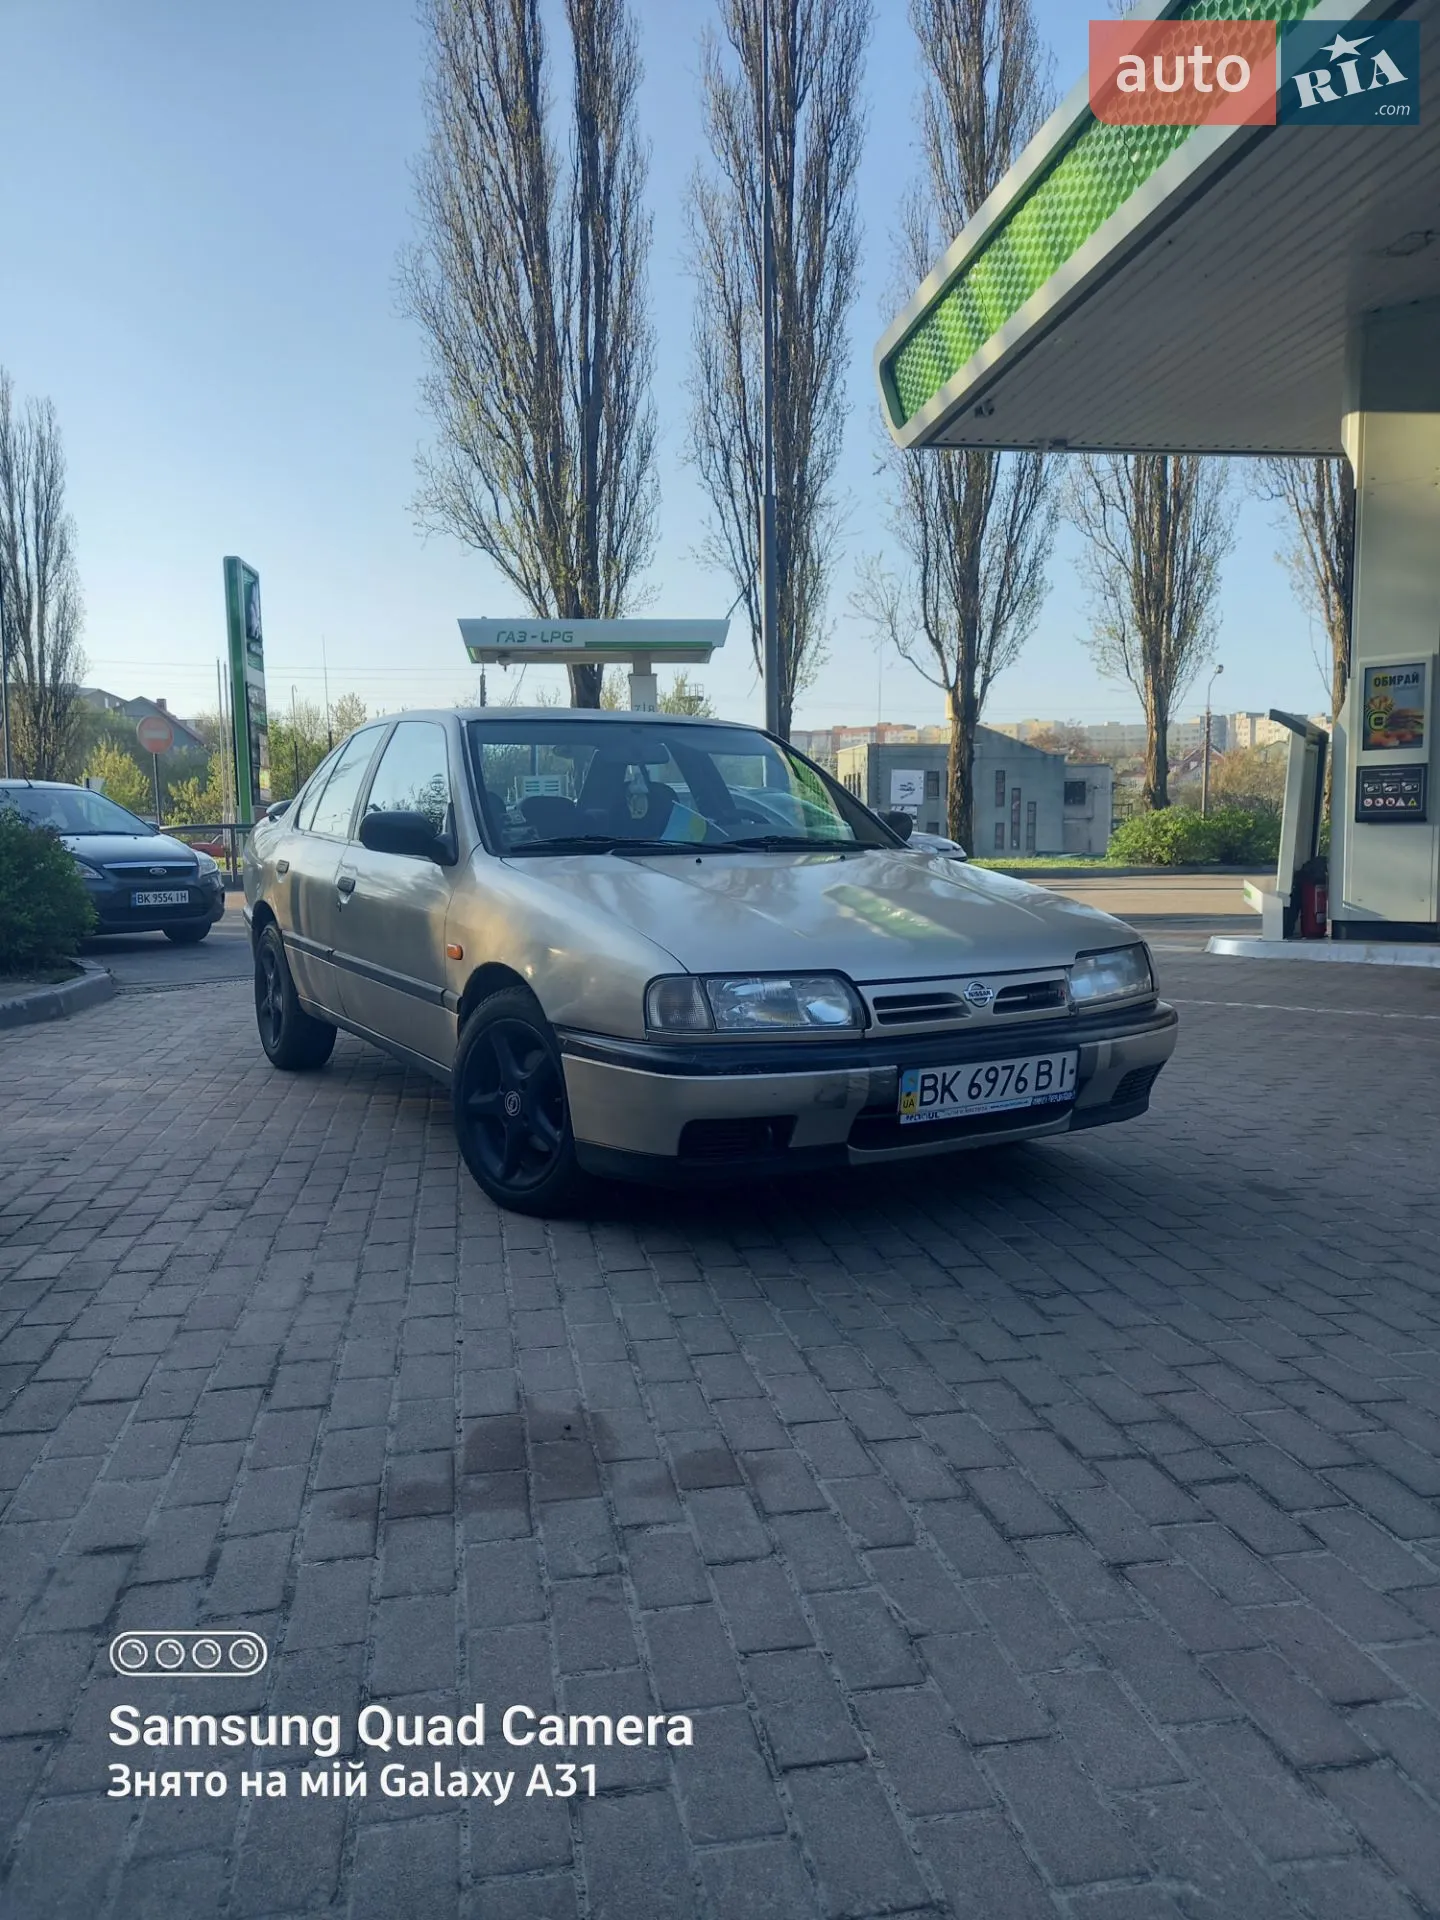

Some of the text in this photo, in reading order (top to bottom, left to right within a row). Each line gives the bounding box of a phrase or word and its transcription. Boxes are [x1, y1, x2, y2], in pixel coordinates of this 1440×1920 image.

[496, 631, 527, 643] ГАЗ
[541, 631, 574, 643] LPG
[1374, 672, 1419, 688] ОБИРАЙ
[153, 892, 173, 903] 9554
[968, 989, 991, 998] NISSAN
[919, 1070, 962, 1107] BK
[967, 1062, 1030, 1100] 6976
[902, 1098, 915, 1109] UA
